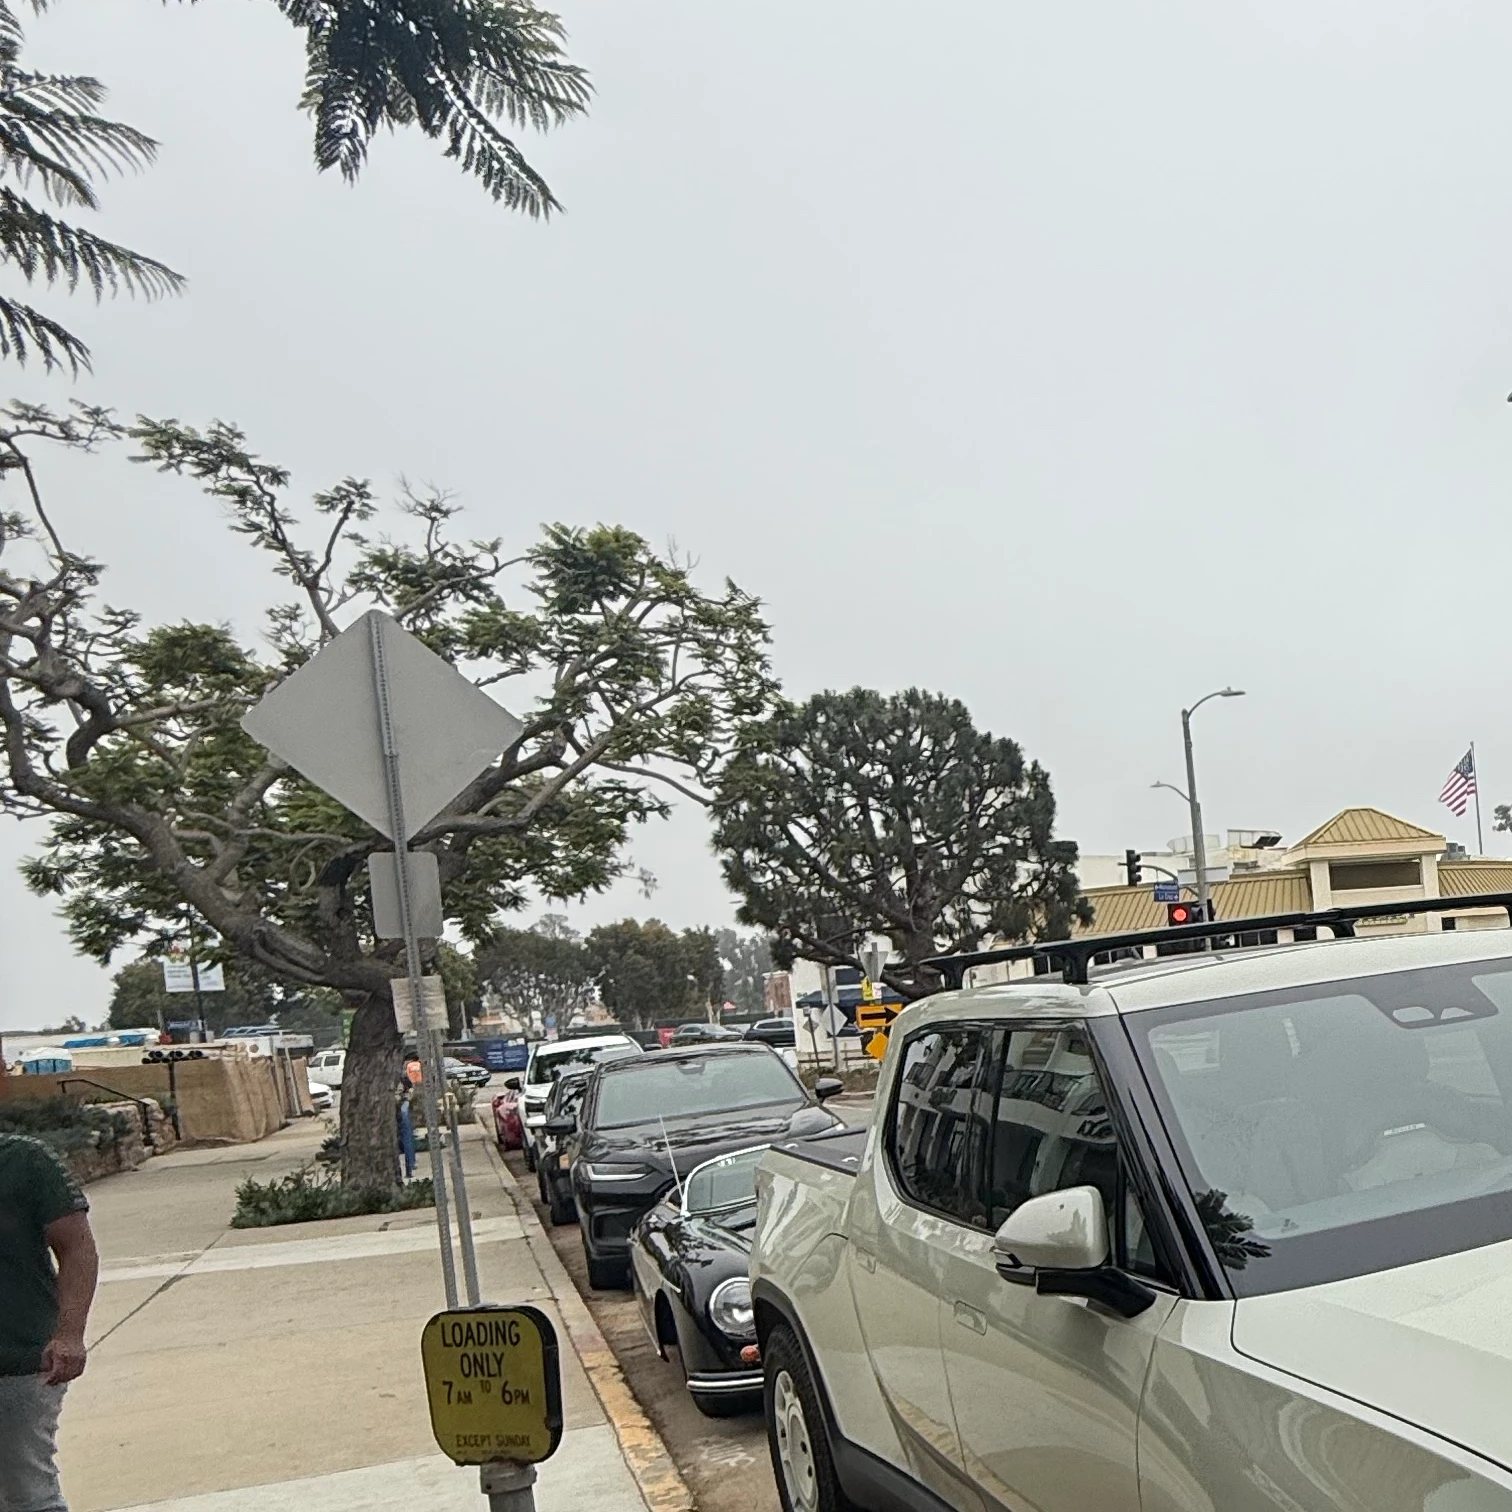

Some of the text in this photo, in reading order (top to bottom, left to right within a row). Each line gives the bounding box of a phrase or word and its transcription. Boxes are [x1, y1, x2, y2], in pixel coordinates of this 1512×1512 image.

[441, 1320, 521, 1348] LOADING
[460, 1352, 505, 1378] ONLY
[480, 1380, 492, 1393] TO
[456, 1434, 531, 1447] EXCEPT SUNDAY
